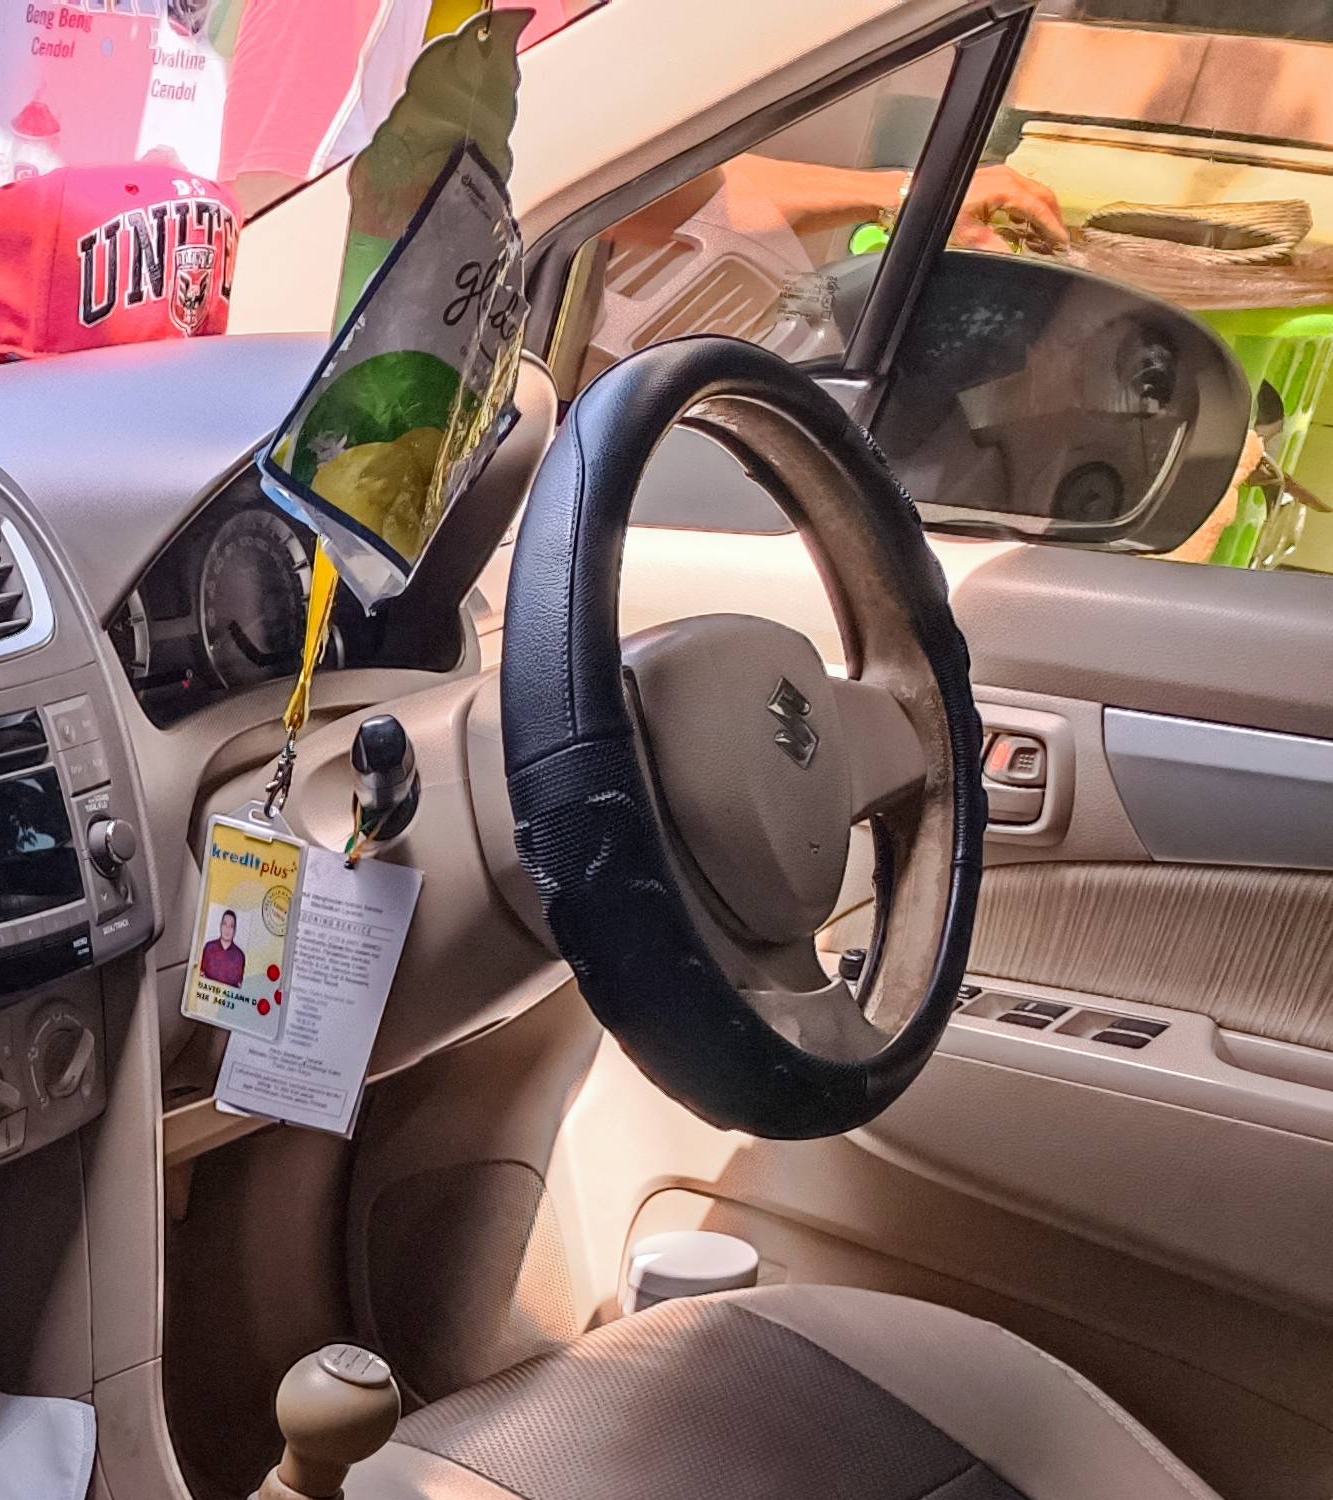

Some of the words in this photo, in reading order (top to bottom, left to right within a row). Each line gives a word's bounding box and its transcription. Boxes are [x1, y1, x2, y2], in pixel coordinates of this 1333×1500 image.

[26, 3, 54, 29] Beng
[58, 7, 93, 33] Beng
[31, 36, 75, 59] Cendol
[151, 79, 197, 102] Cendol
